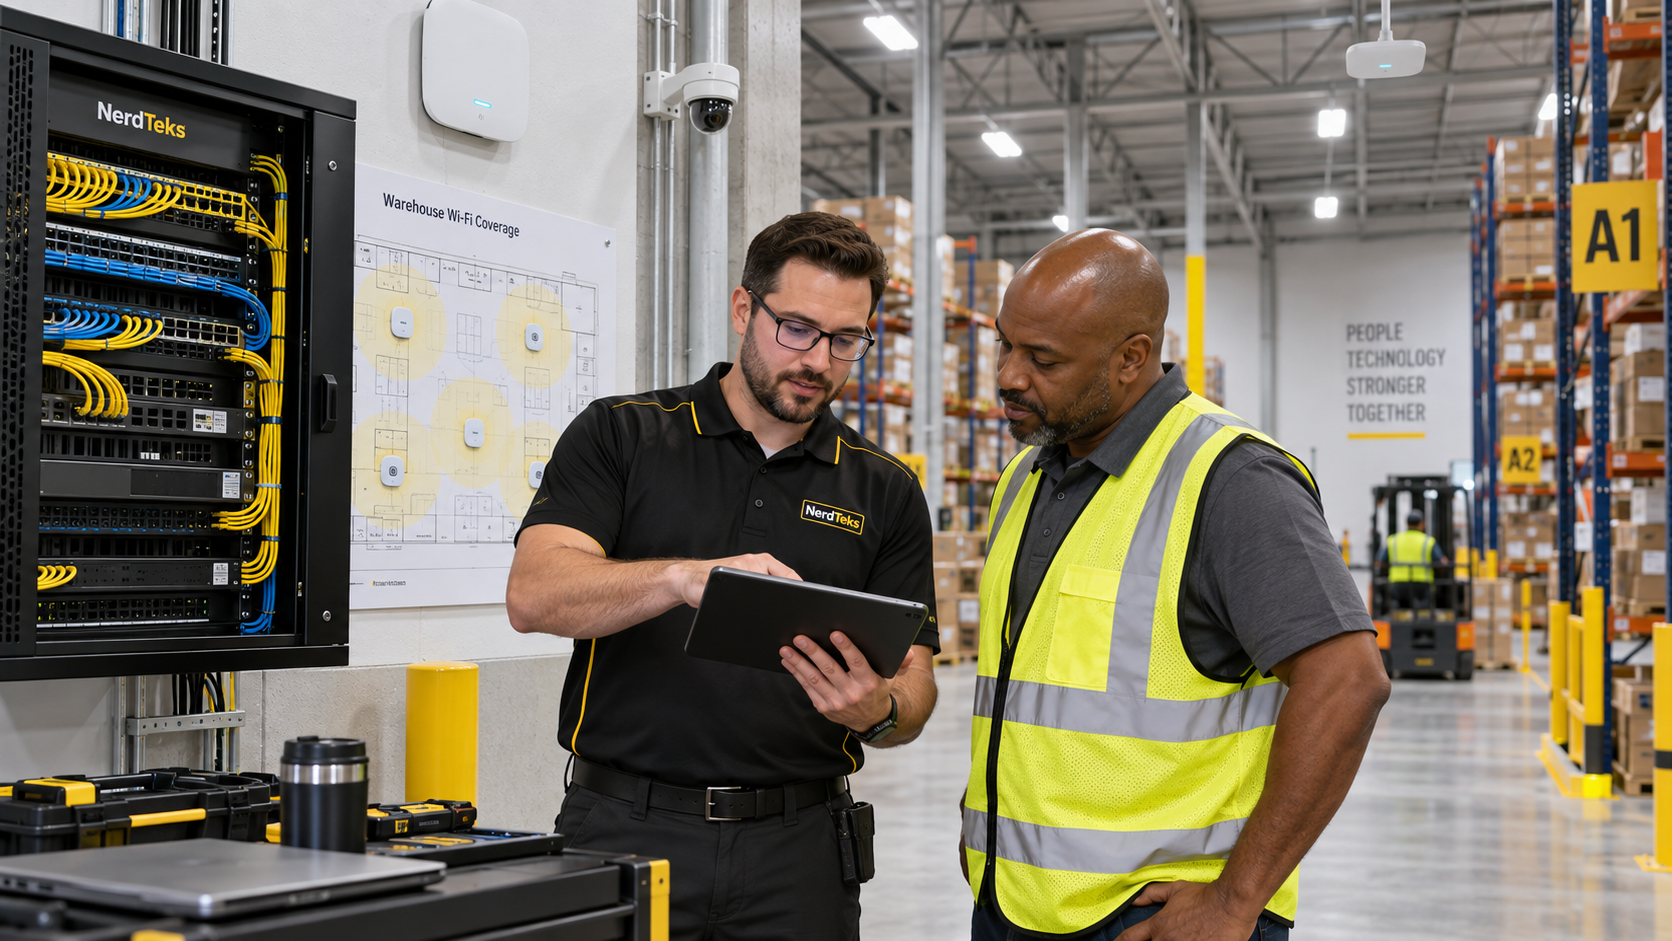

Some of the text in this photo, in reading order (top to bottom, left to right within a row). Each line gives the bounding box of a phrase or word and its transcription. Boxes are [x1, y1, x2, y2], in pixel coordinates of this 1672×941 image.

[97, 101, 186, 139] NerdTeks
[383, 192, 520, 239] Warehouse Wi-Fi Coverage
[1584, 207, 1640, 263] A1
[1346, 322, 1403, 342] PEOPLE
[1346, 348, 1446, 369] TECHNOLOGY
[1346, 376, 1426, 396] STRONGER
[1346, 403, 1426, 422] TOGETHER
[1507, 448, 1536, 472] A2
[805, 504, 860, 529] NerdTeks
